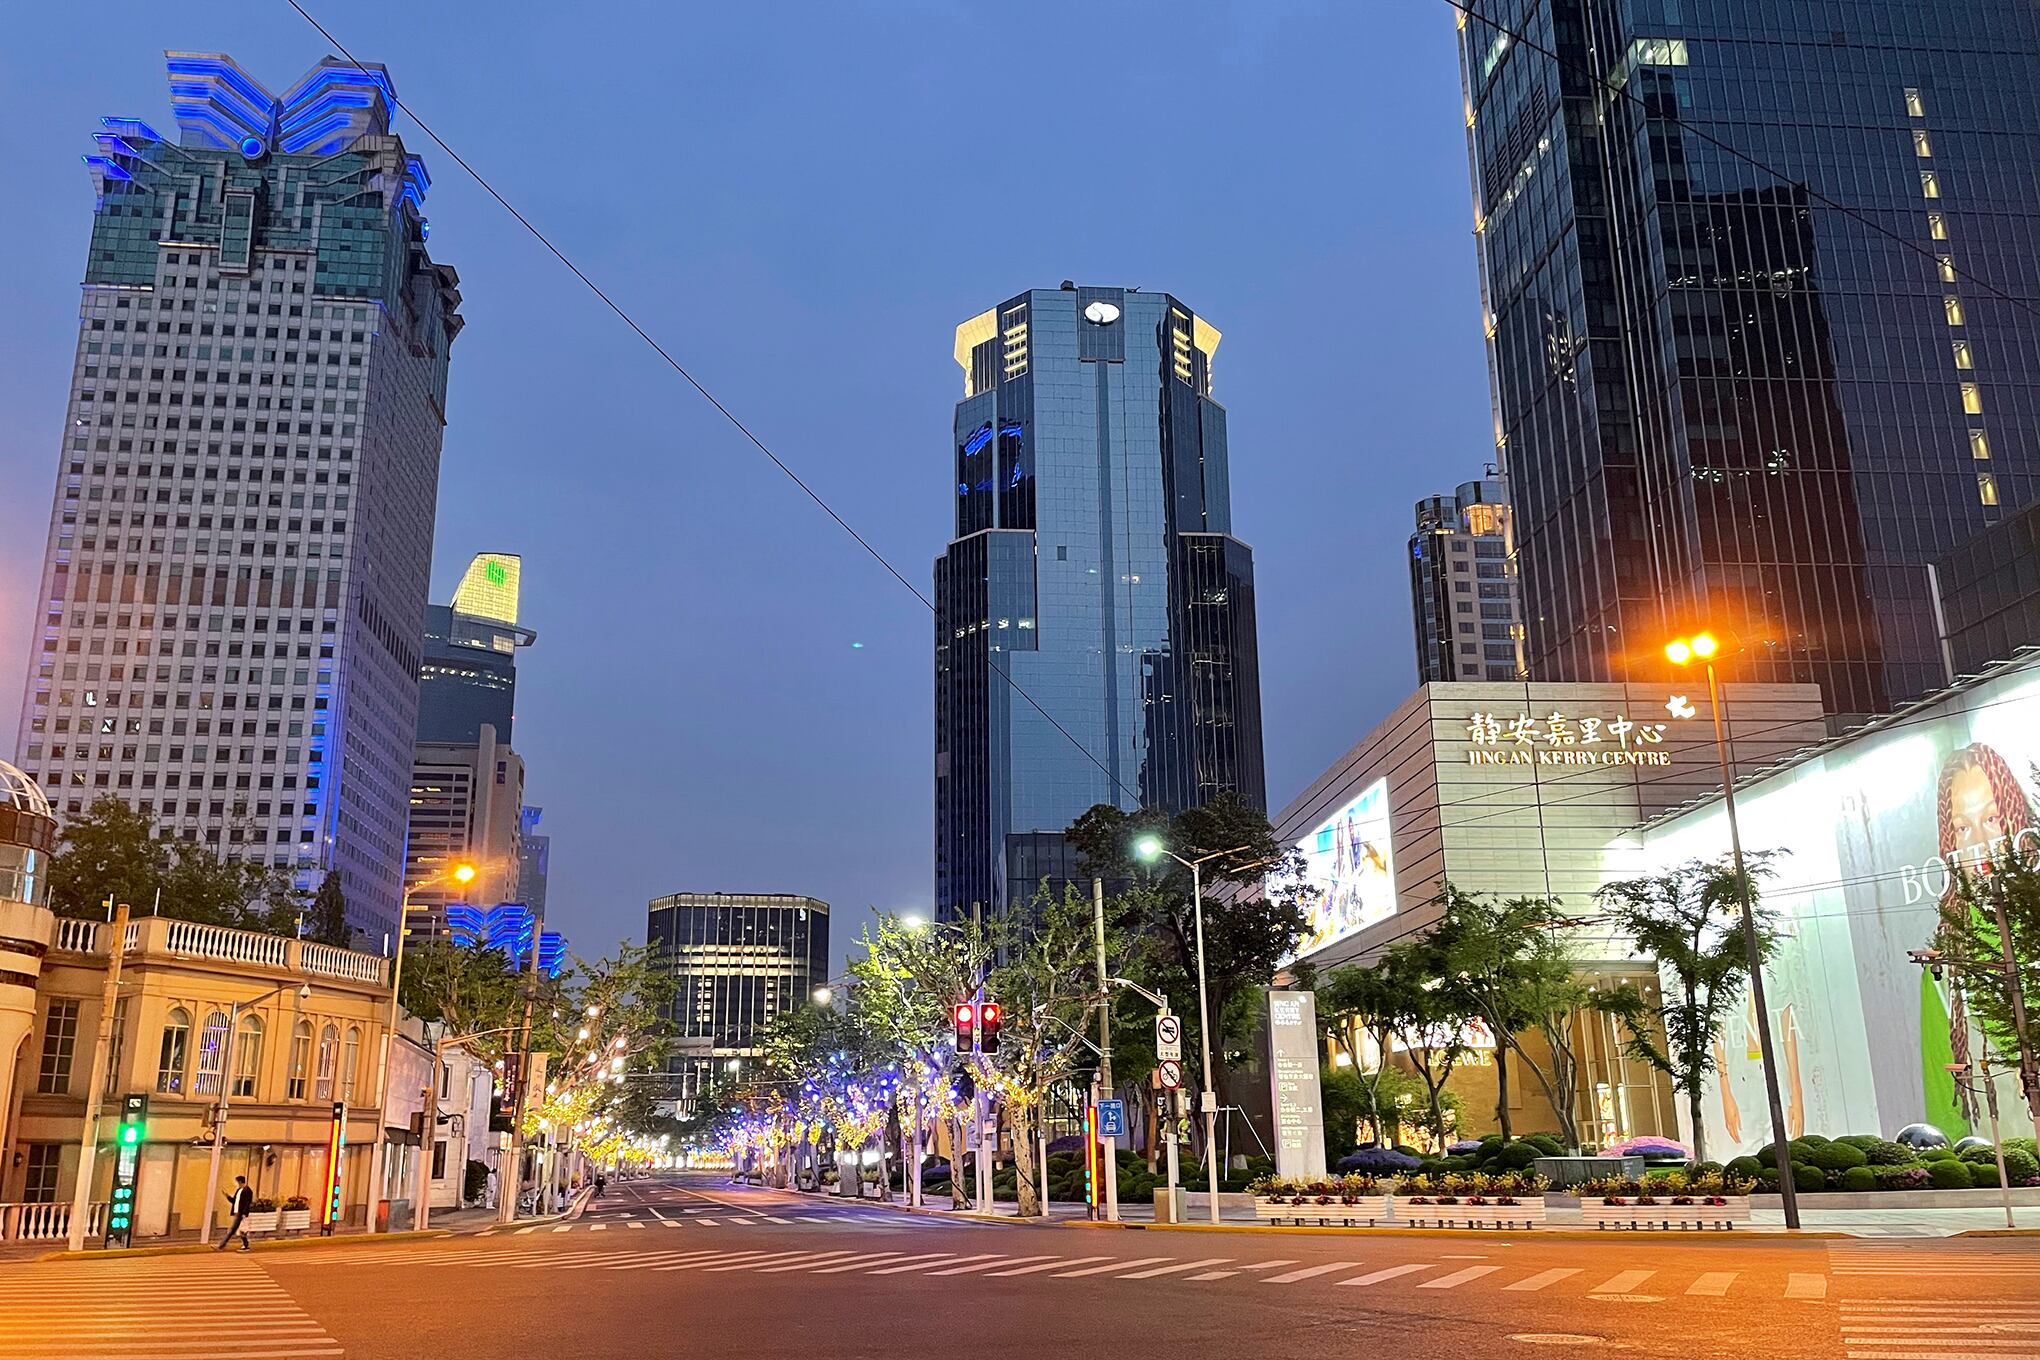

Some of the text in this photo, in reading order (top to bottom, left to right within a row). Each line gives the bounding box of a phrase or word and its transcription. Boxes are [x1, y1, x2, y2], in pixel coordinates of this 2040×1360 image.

[1466, 711, 1667, 749] 静安嘉里中心
[1539, 752, 1598, 765] KERRY
[1602, 752, 1671, 766] CENTRE
